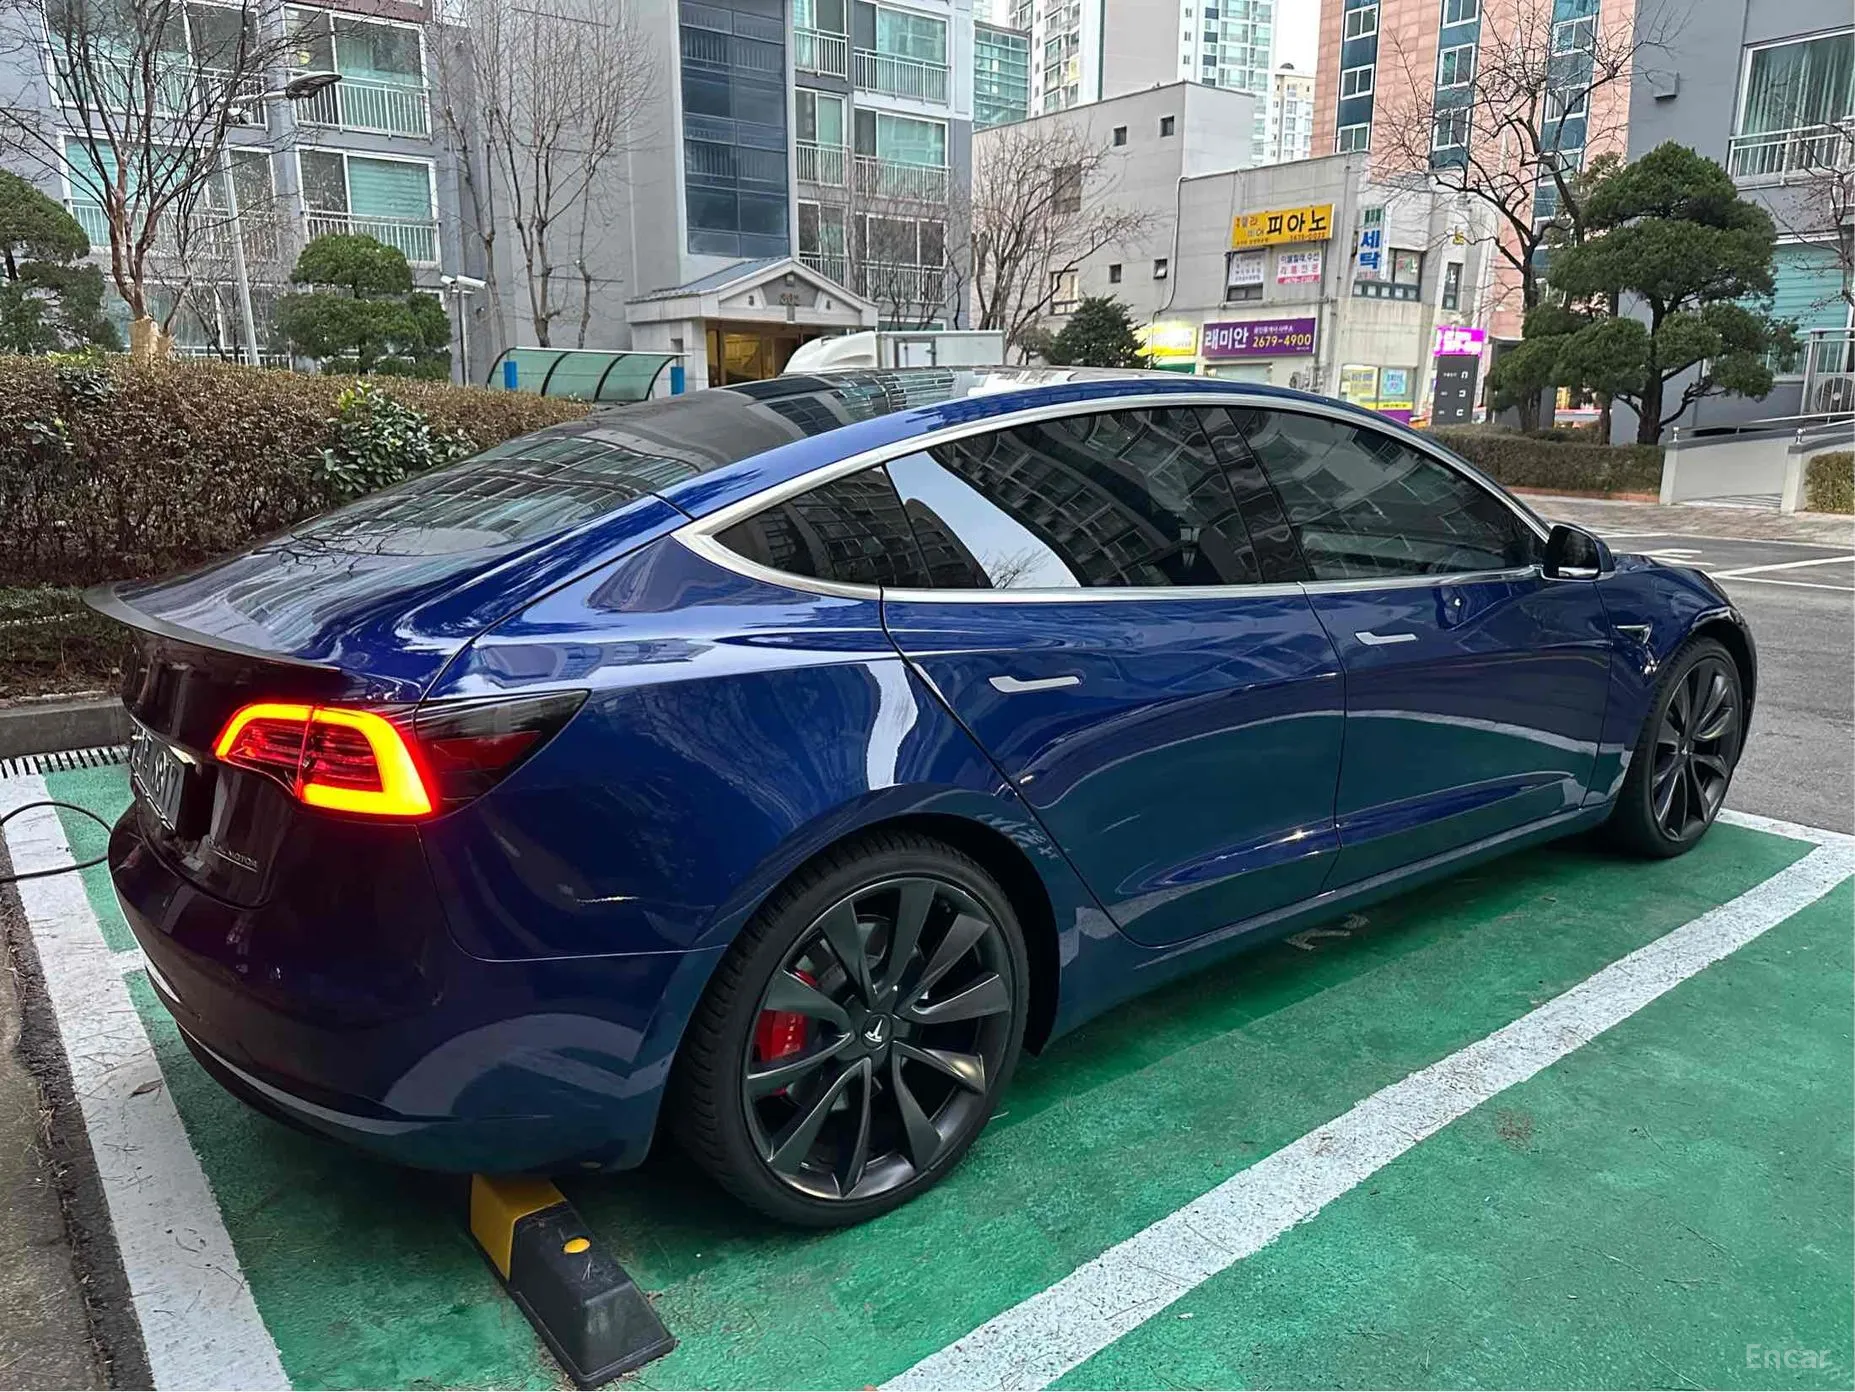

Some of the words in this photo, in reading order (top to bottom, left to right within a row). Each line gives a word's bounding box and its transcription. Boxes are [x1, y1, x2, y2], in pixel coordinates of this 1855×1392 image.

[1266, 209, 1327, 235] 피아노
[1360, 229, 1381, 269] 세탁
[1205, 327, 1249, 351] 래미안
[1252, 334, 1312, 349] 2679-4900
